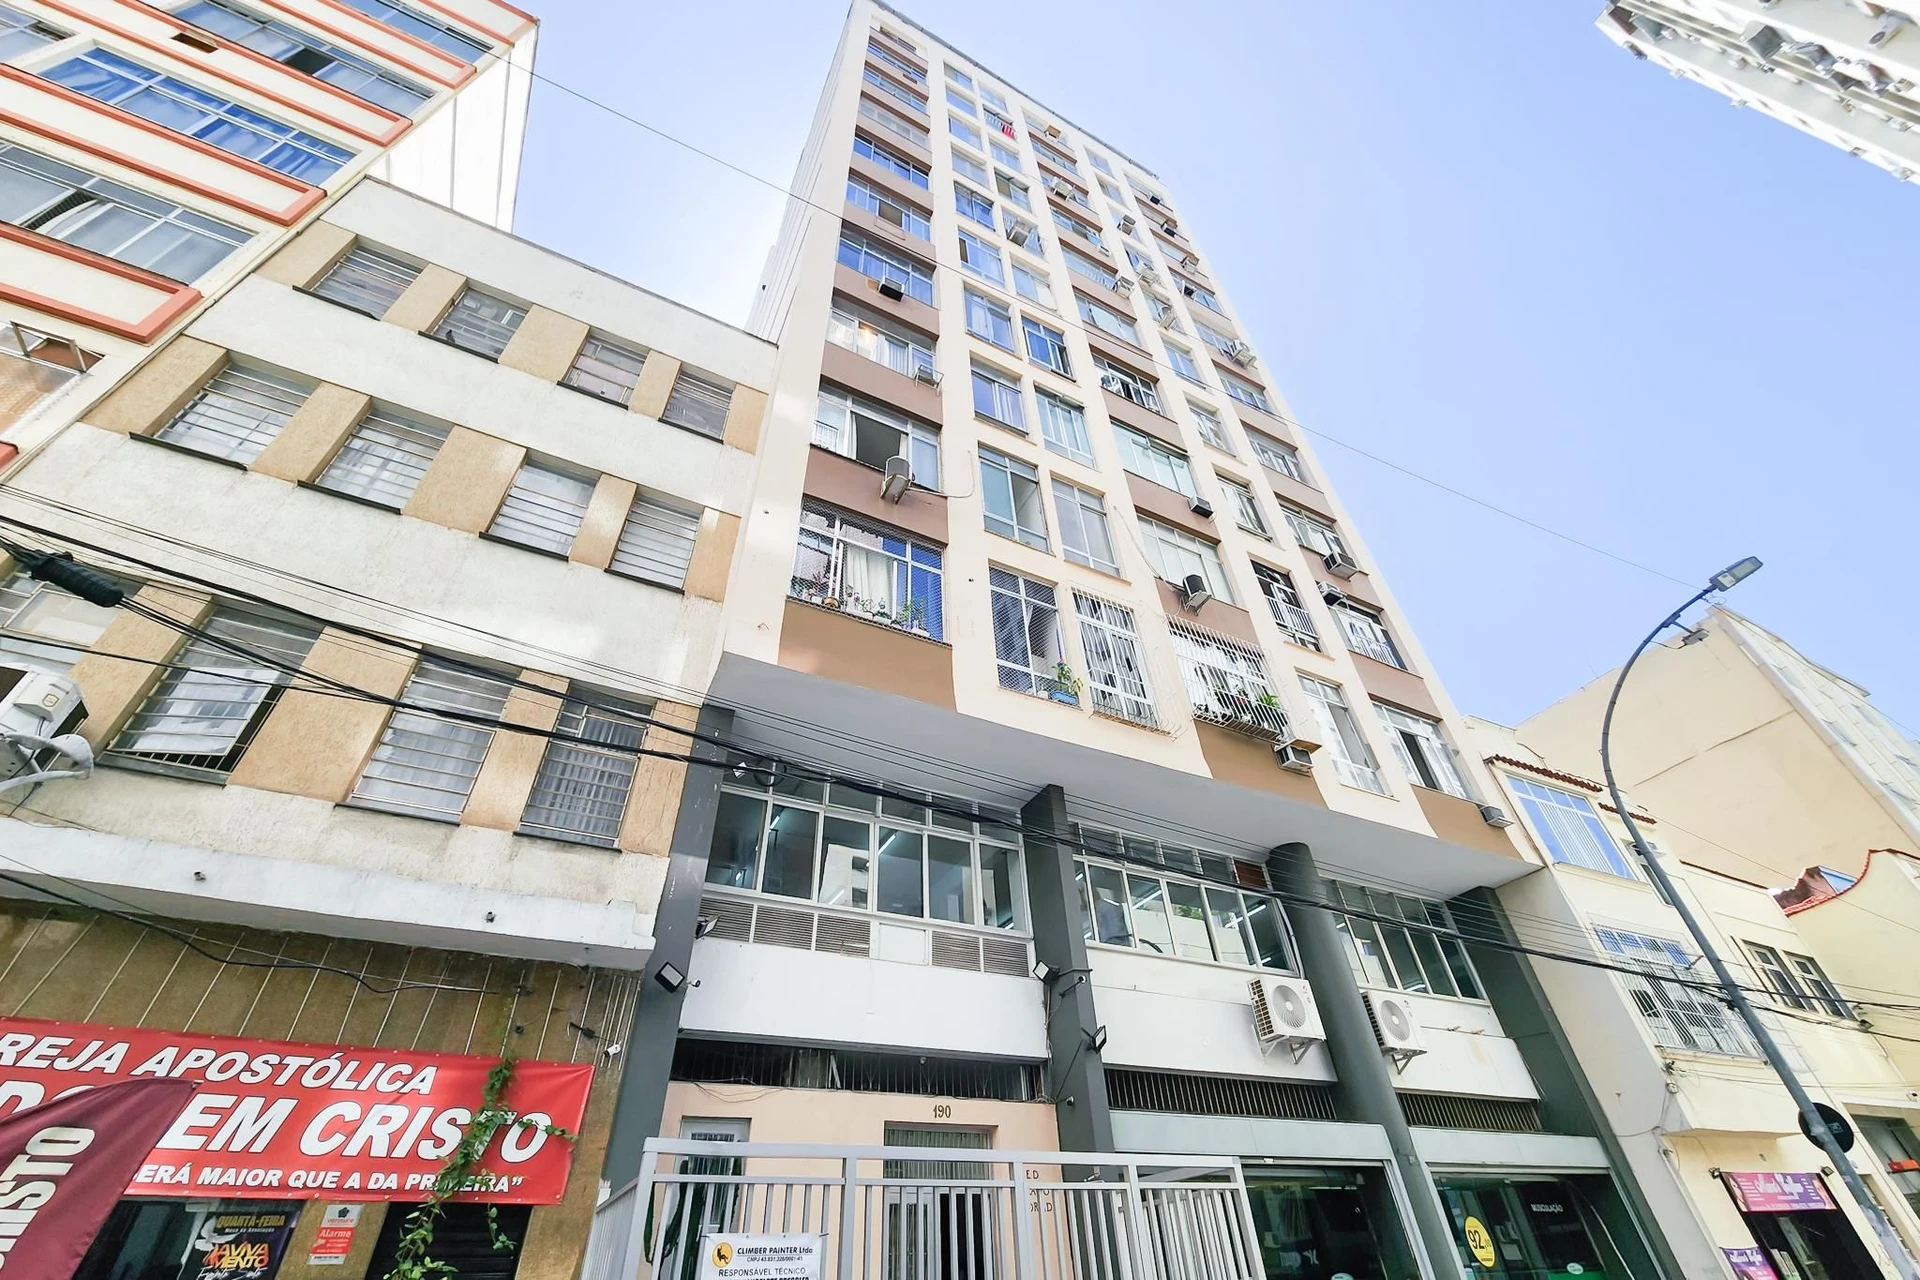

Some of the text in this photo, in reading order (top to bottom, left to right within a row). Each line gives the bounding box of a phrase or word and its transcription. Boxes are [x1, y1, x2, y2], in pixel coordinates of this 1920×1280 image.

[129, 1046, 438, 1095] APOSTÓLICA
[933, 1105, 952, 1119] 190
[155, 1092, 298, 1153] EM
[132, 1163, 193, 1185] ERÁ
[196, 1166, 280, 1188] MAIOR
[287, 1170, 341, 1190] QUE
[343, 1171, 361, 1189] A
[366, 1173, 398, 1191] DA
[318, 1229, 352, 1239] Alarme
[737, 1247, 768, 1255] CLIMBER
[768, 1246, 798, 1254] PAINTER
[718, 1267, 772, 1277] RESPONSÁVEL
